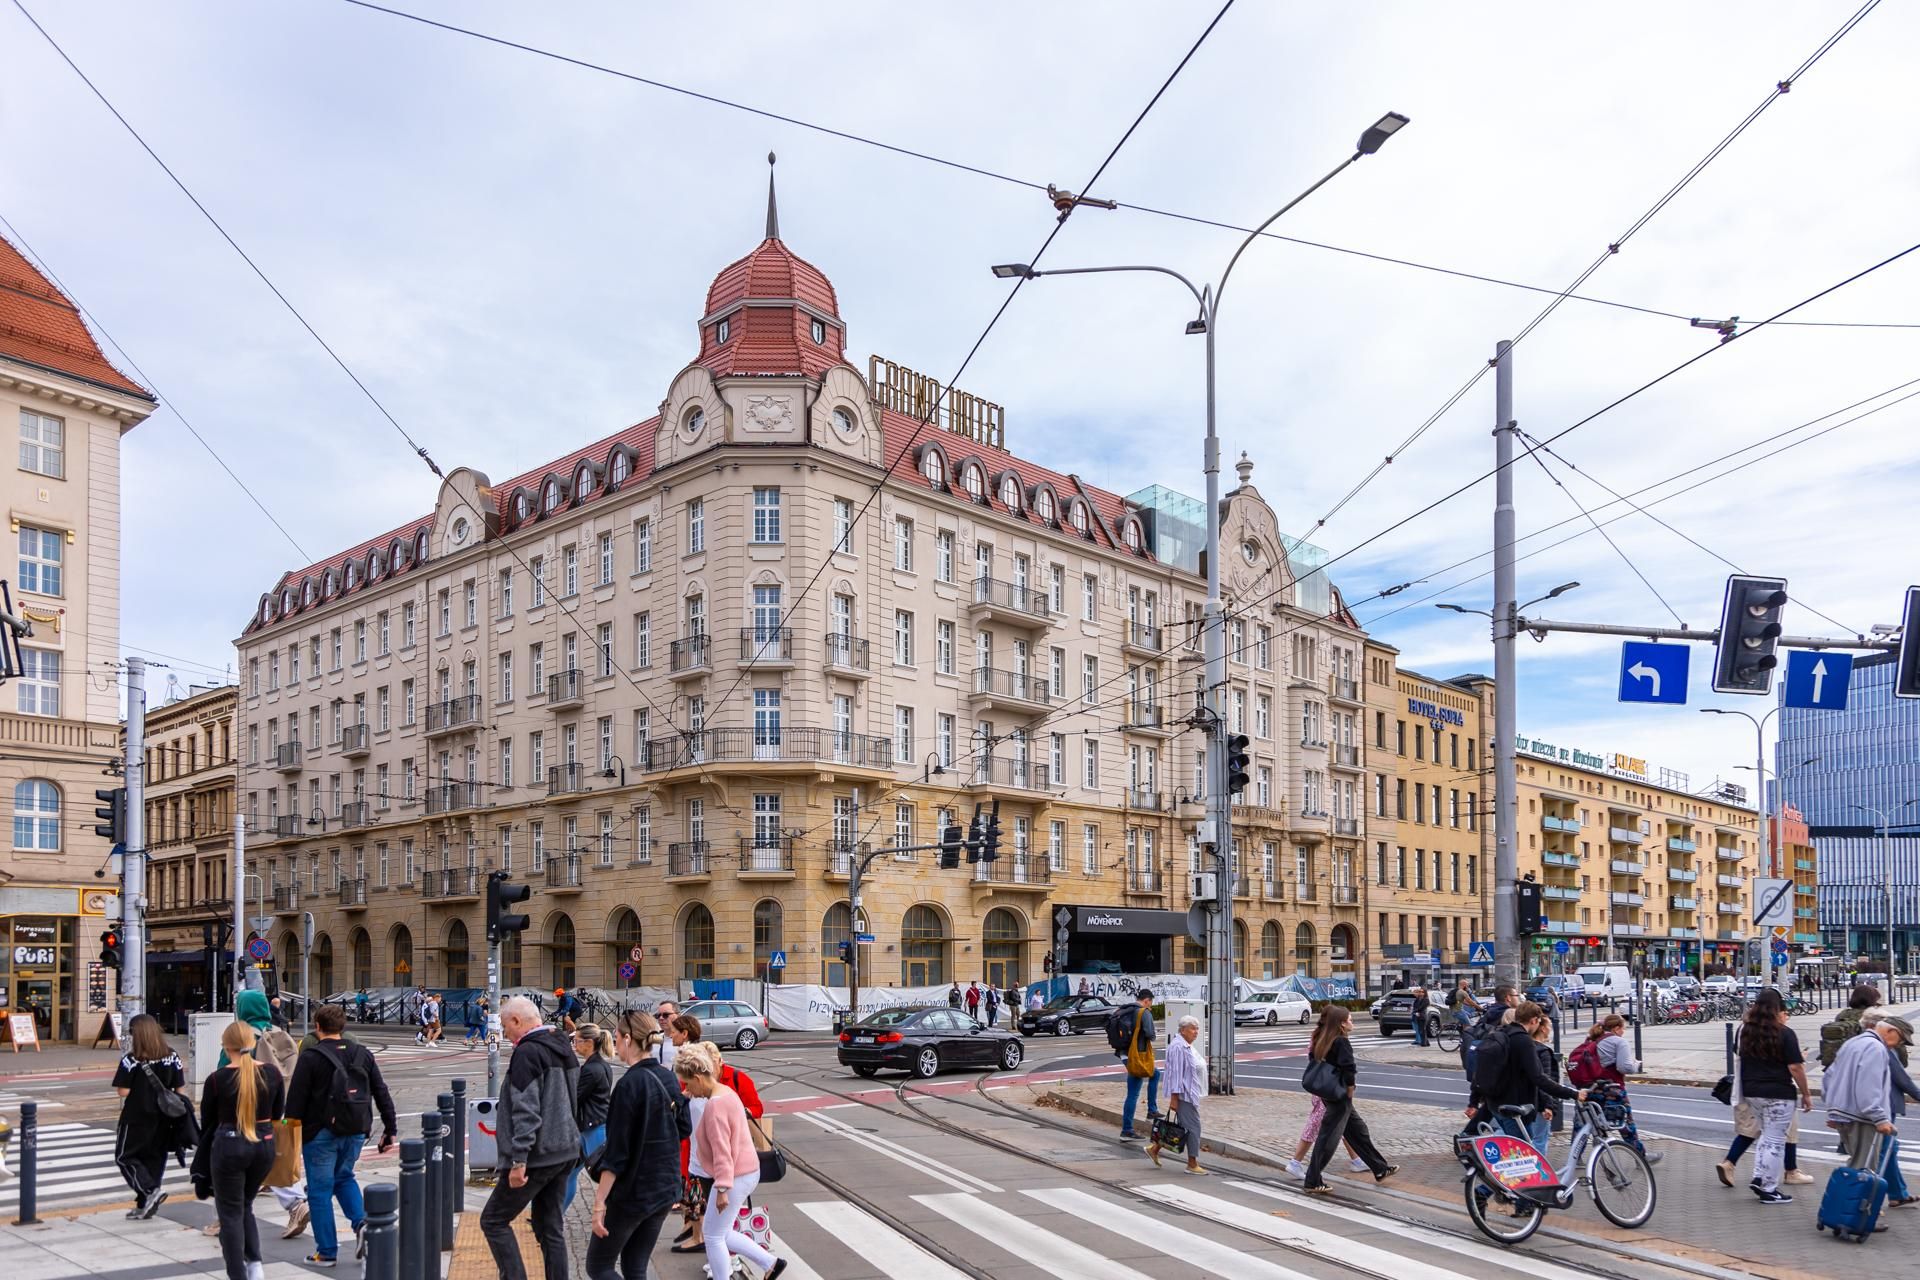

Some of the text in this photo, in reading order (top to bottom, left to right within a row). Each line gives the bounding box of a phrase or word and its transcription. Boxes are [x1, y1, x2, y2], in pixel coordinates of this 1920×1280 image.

[869, 354, 1005, 451] GRAND HOTEL
[1408, 698, 1463, 727] HOTEL SOFIA
